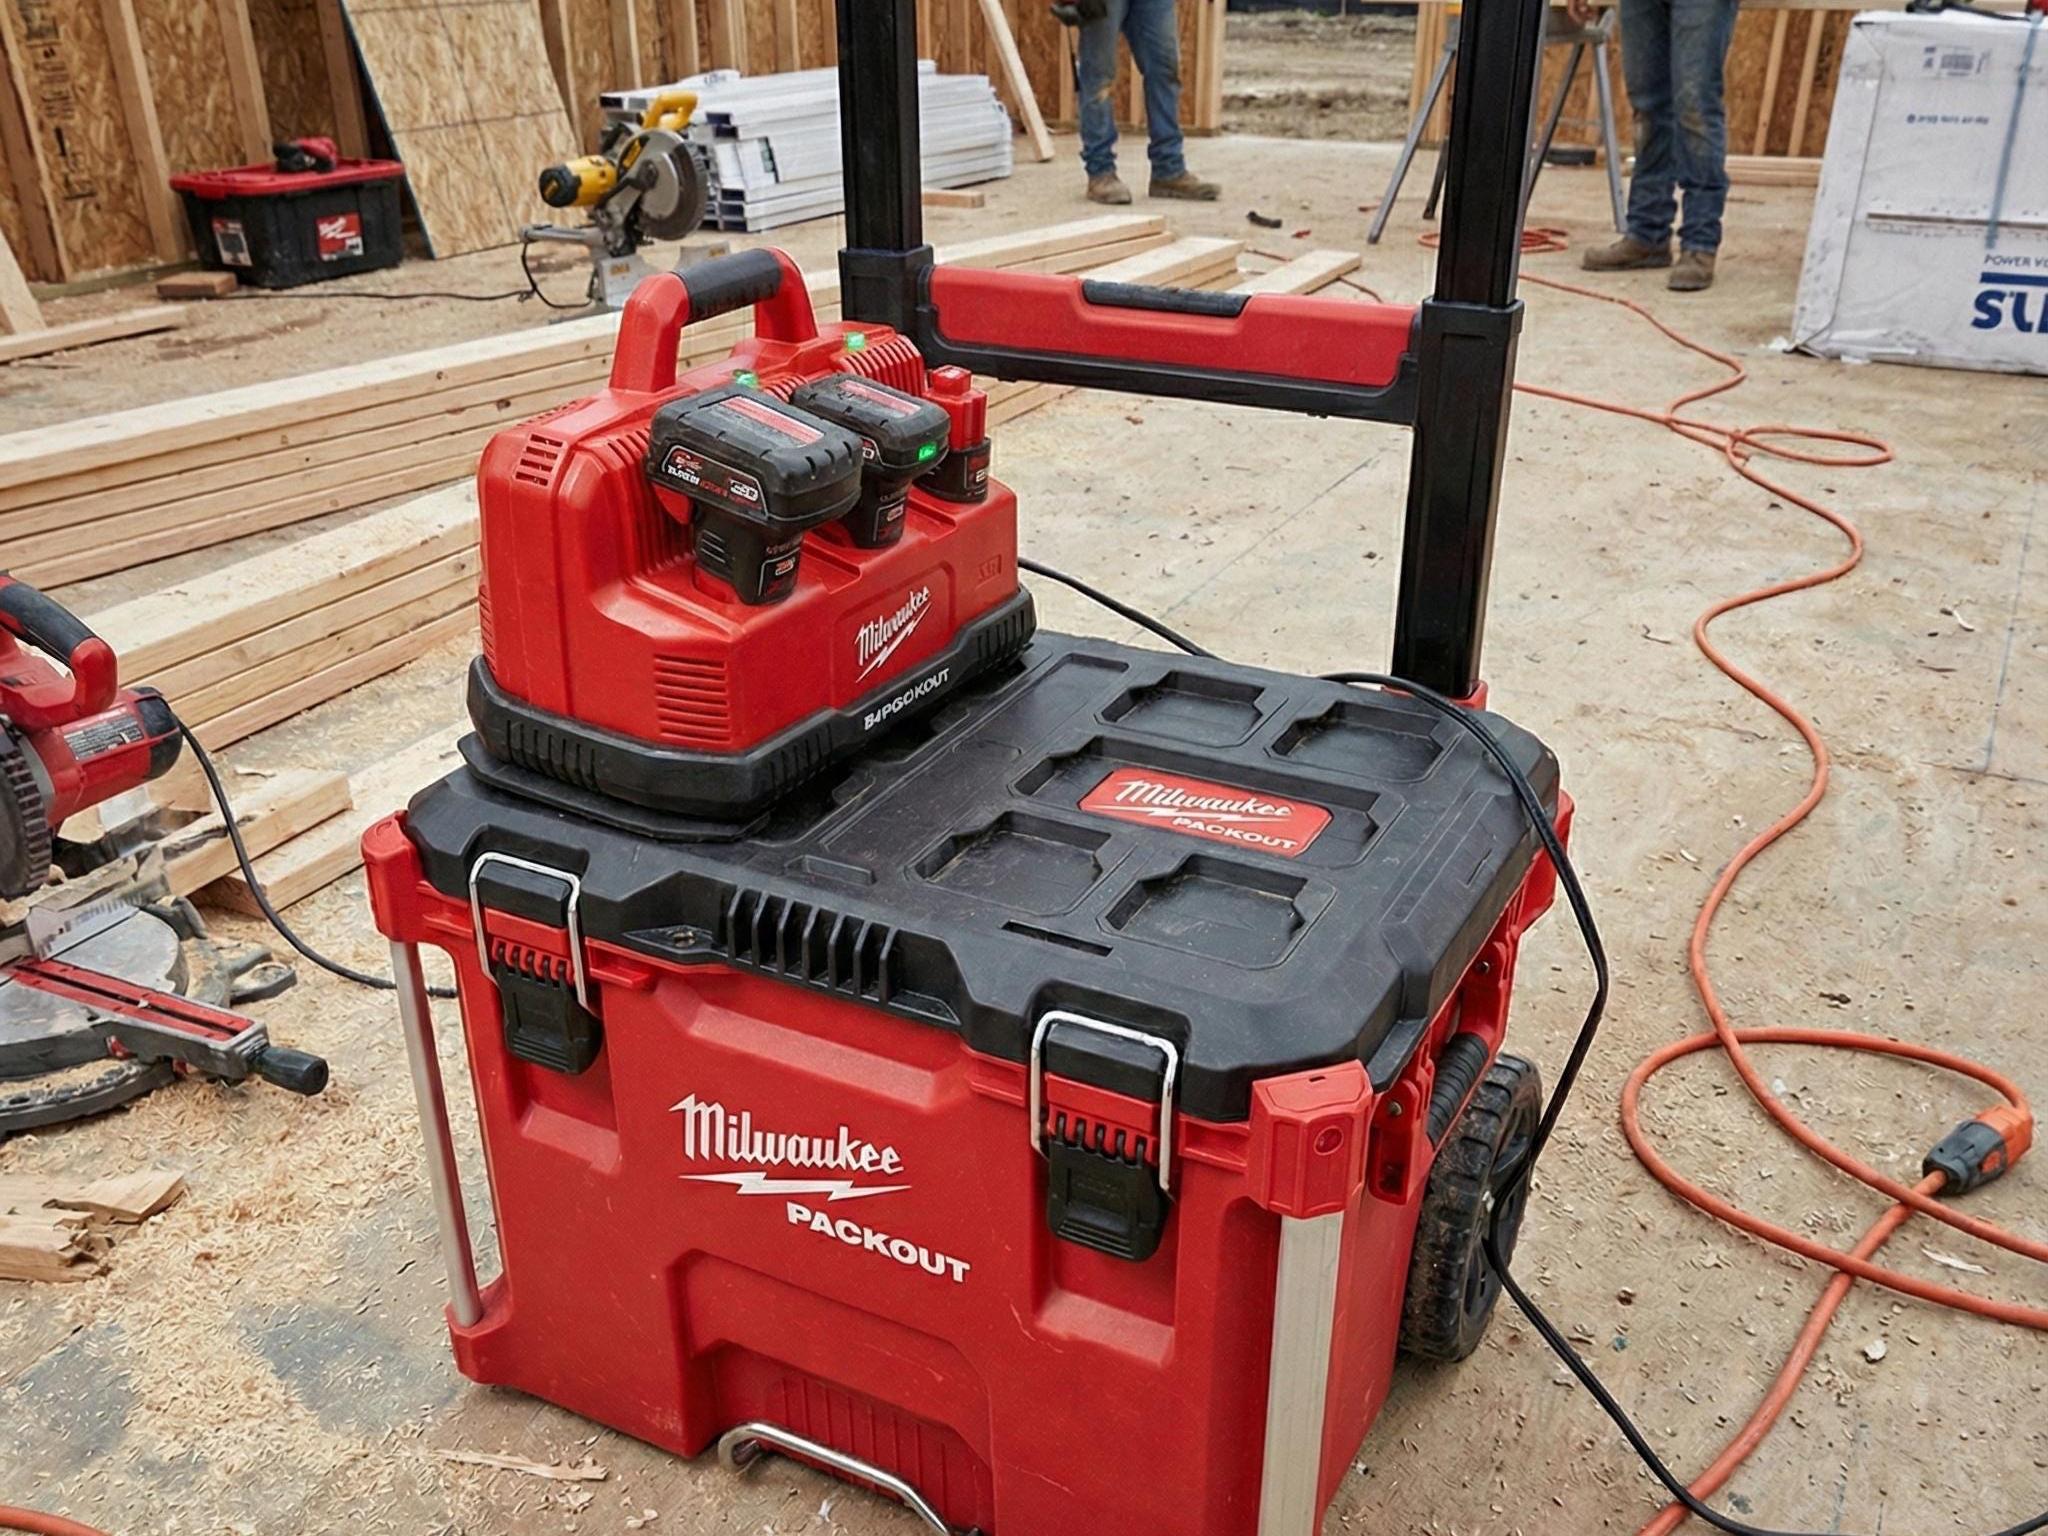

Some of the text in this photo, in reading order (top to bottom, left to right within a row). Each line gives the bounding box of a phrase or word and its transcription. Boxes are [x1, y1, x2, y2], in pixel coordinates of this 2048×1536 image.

[854, 586, 930, 666] Milwaukee
[1116, 779, 1293, 817] Milwaukee
[1172, 817, 1298, 850] PACKOUT
[669, 1093, 904, 1175] Milwaukee
[786, 1201, 971, 1283] PACKOUT
